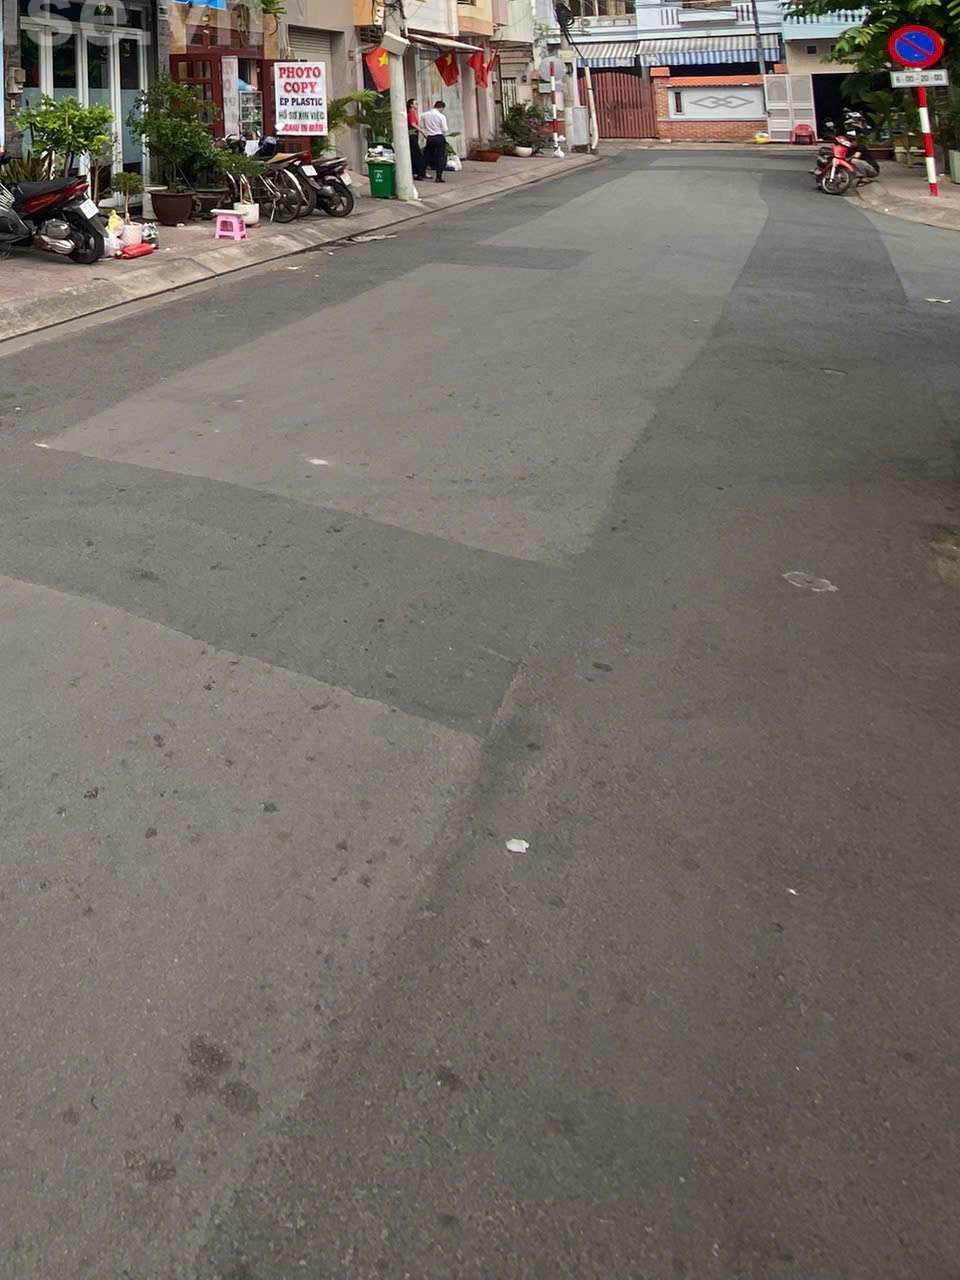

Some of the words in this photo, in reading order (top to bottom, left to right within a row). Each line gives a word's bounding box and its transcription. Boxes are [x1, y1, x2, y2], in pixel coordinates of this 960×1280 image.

[278, 66, 321, 79] PHOTO
[283, 81, 317, 93] COPY
[291, 97, 323, 106] PLASTIC
